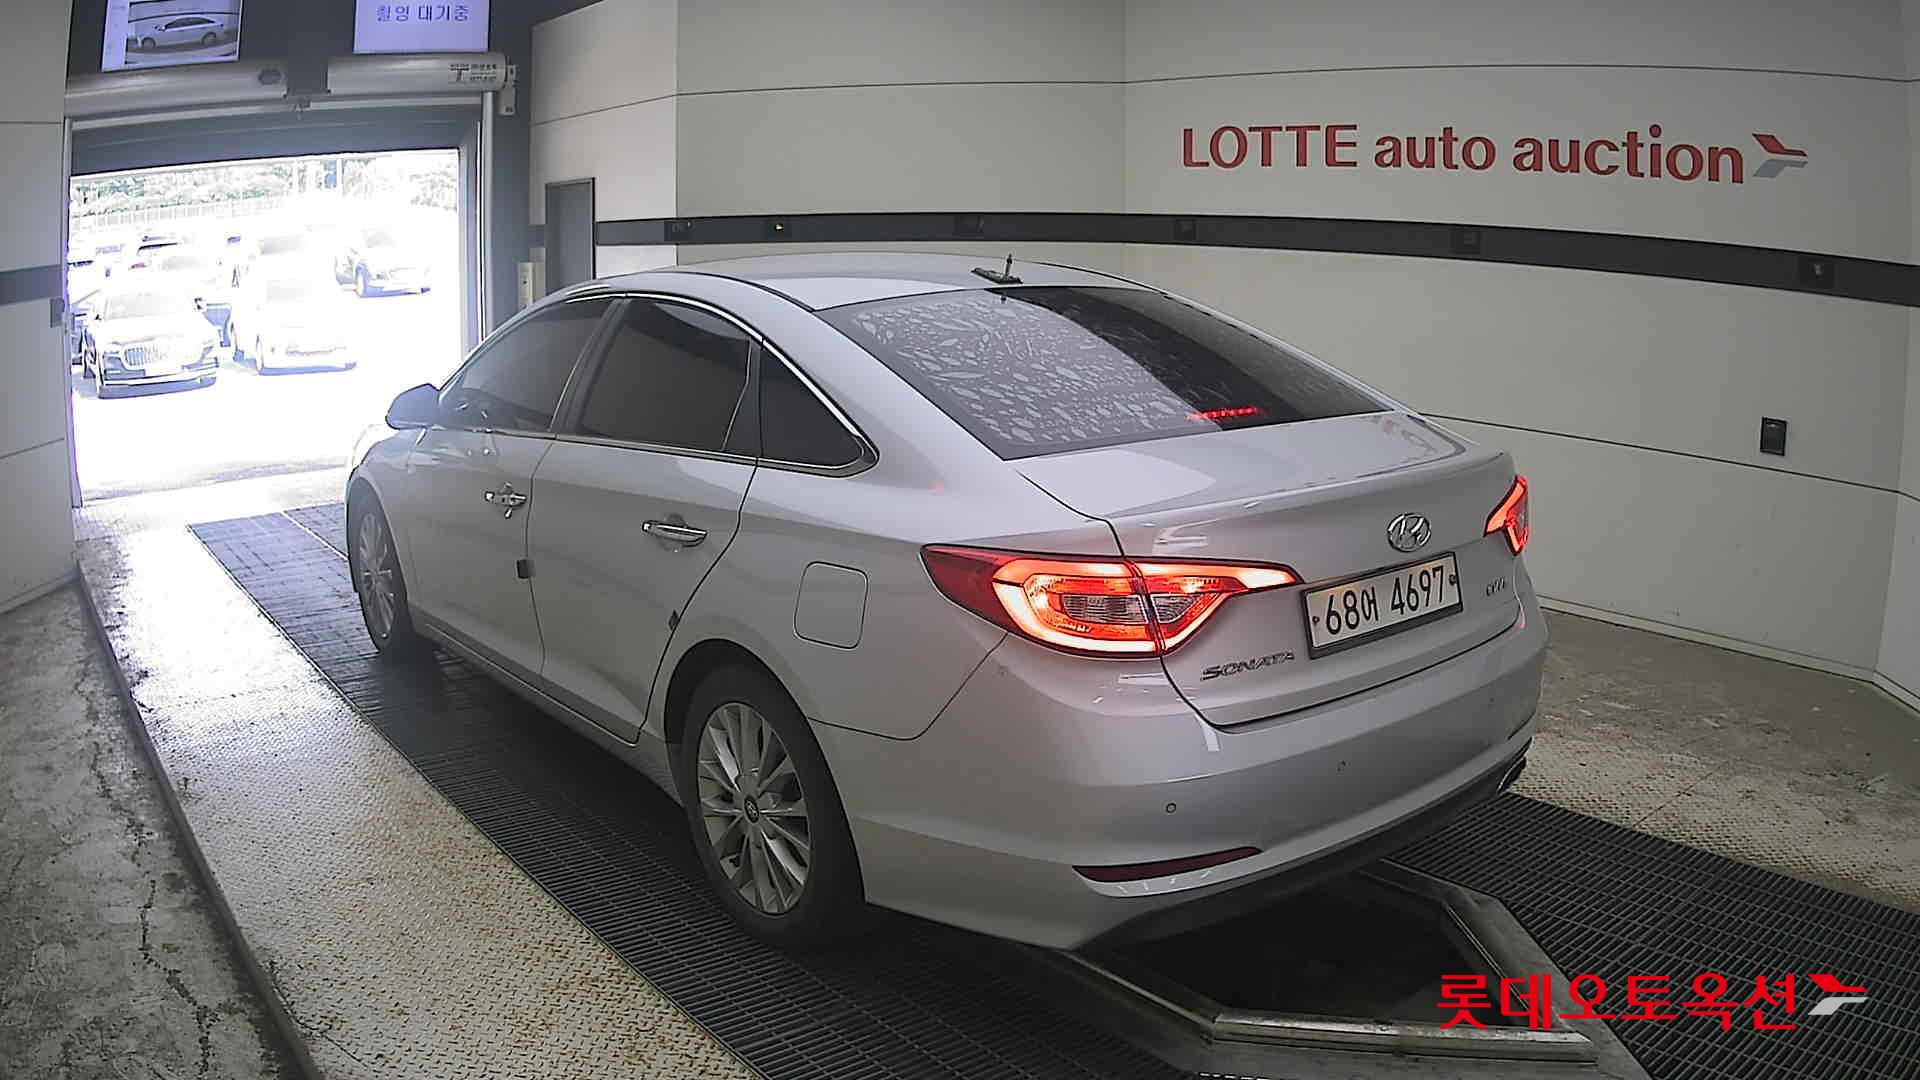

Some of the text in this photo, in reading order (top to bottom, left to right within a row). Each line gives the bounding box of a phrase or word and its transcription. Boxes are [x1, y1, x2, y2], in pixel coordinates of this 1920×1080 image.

[418, 5, 468, 21] 대기중
[1183, 124, 1745, 184] LOTTE auto auction
[1326, 586, 1379, 635] 68어
[1391, 565, 1444, 615] 4697
[1201, 652, 1295, 681] SONATA
